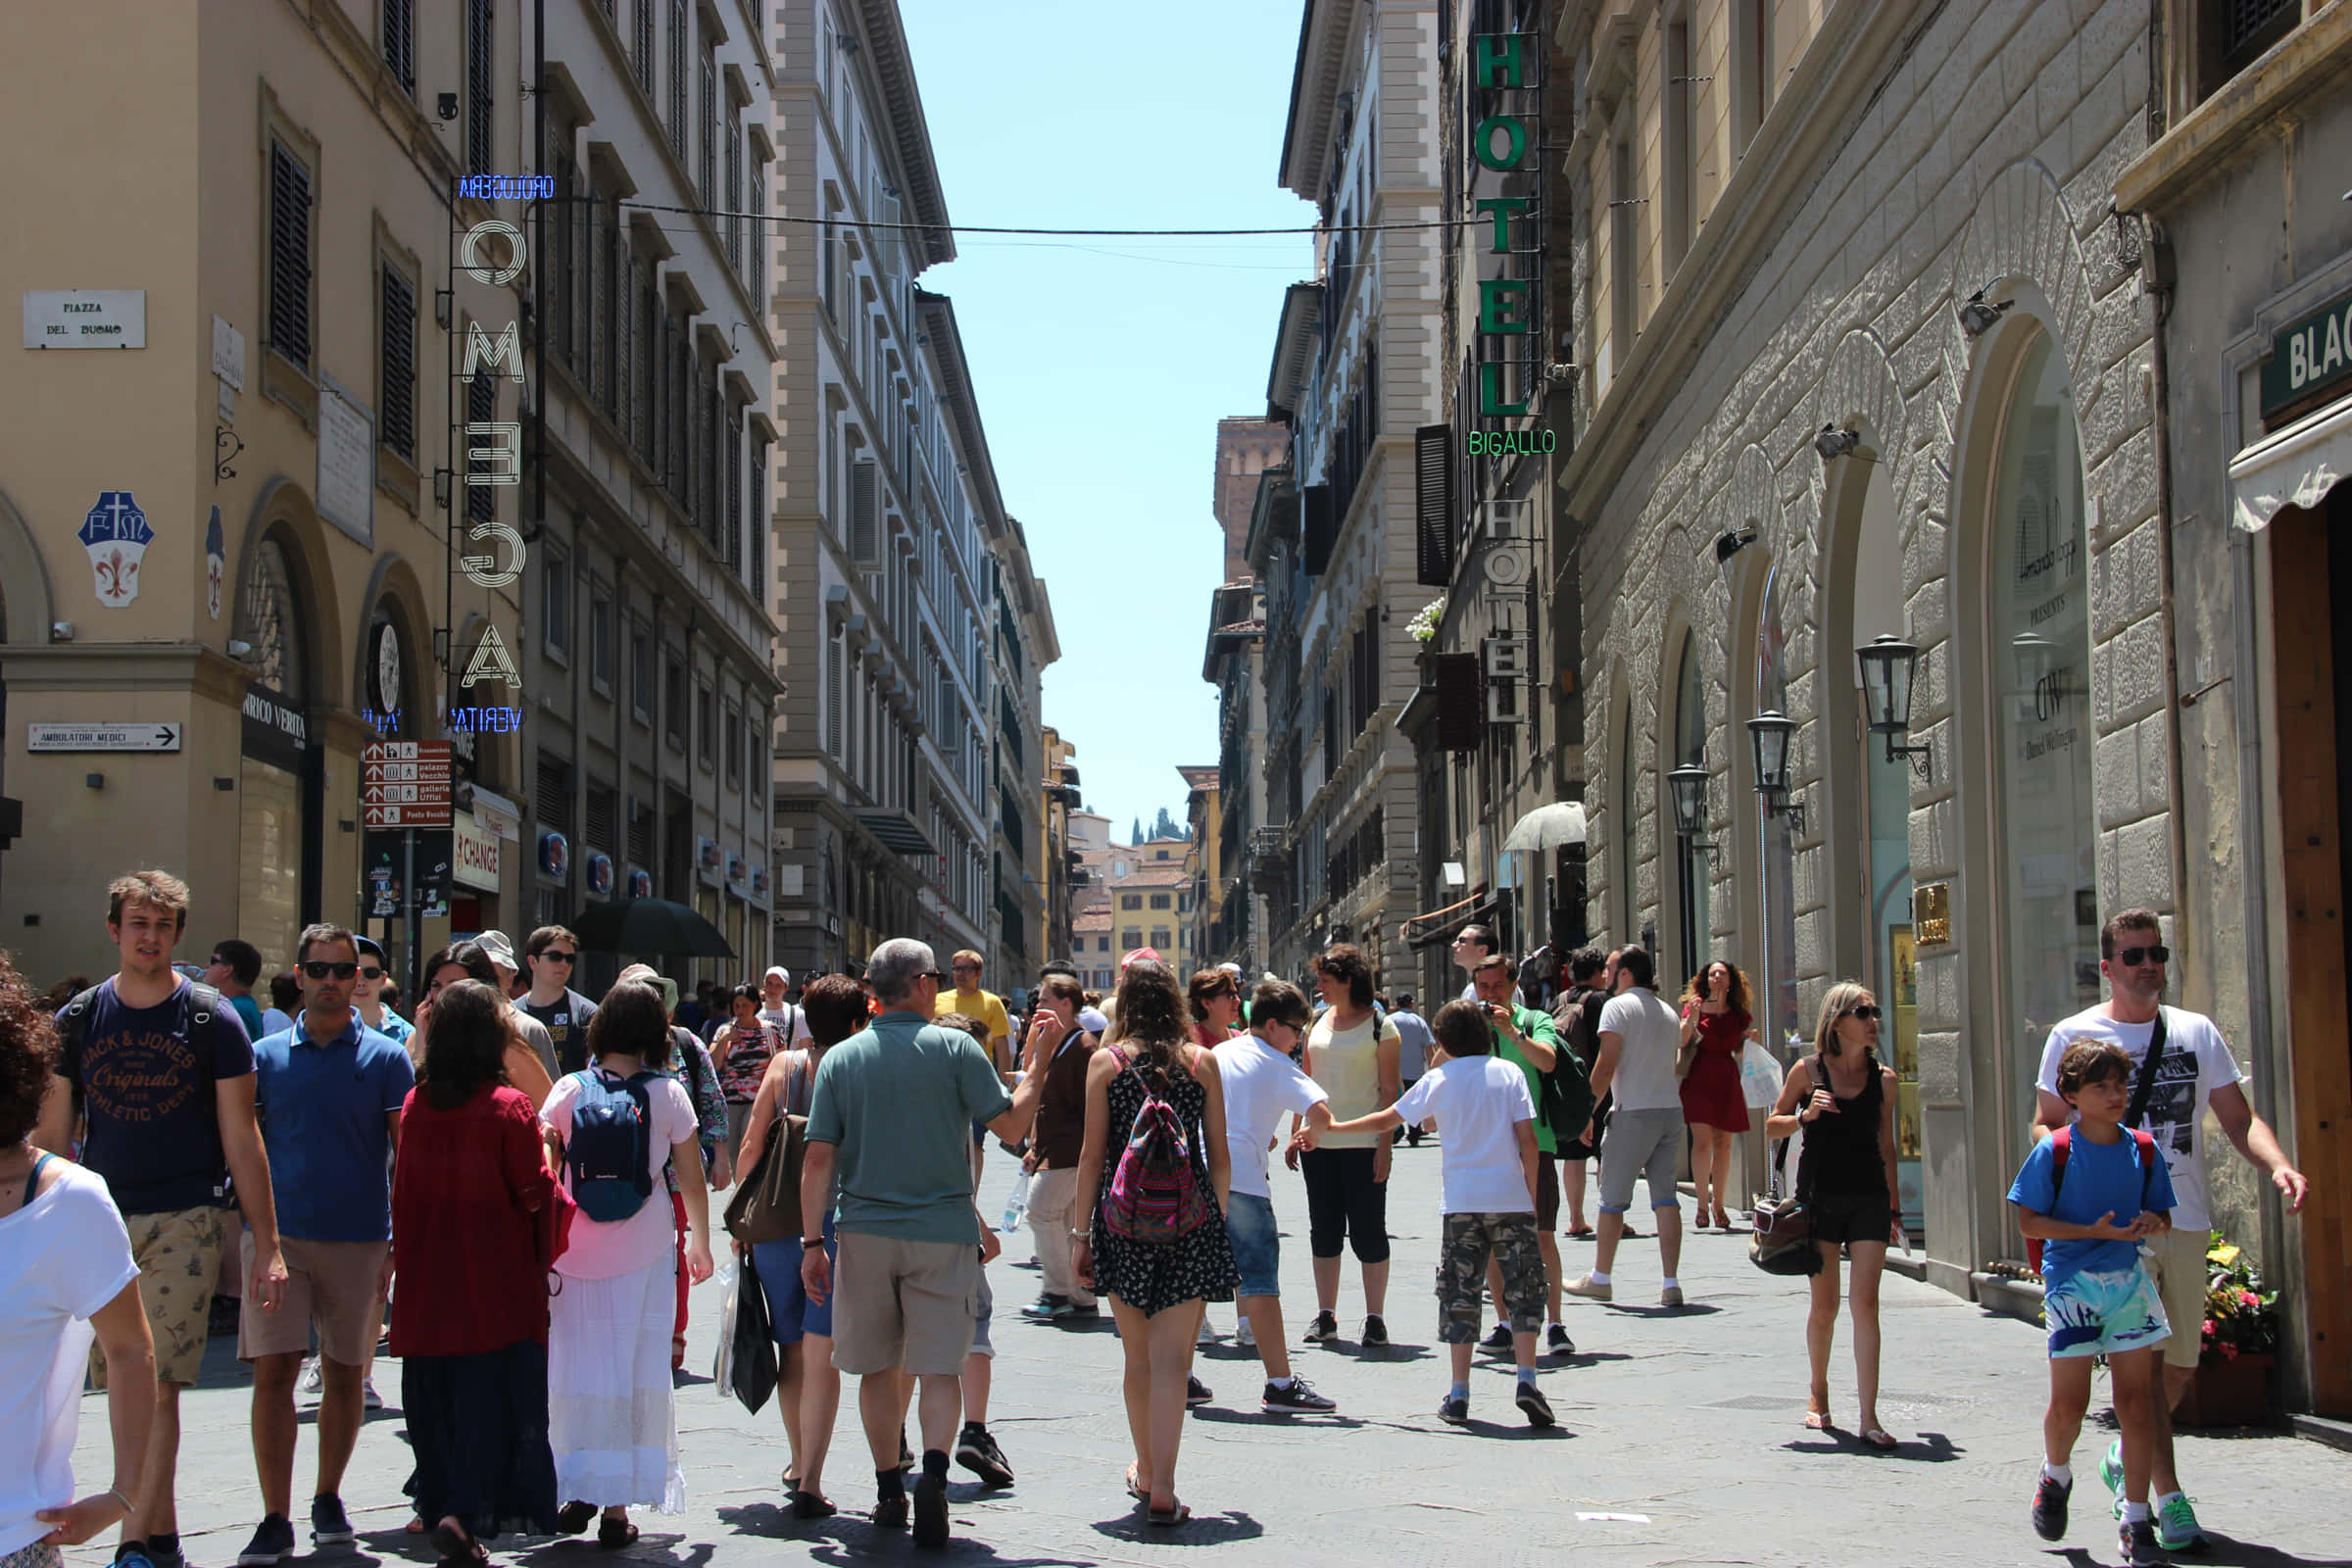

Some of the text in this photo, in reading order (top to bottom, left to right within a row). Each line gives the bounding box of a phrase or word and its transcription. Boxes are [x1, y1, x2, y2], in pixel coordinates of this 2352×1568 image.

[1475, 33, 1528, 416] HOTEL
[63, 303, 102, 313] PIAZZA
[46, 325, 122, 334] DEL DUOMO
[1469, 430, 1556, 455] BIGALLO
[1483, 500, 1525, 723] HOTEL
[2030, 593, 2065, 627] PRESENTS
[40, 732, 126, 742] AMBULATORI MEDICI
[418, 763, 450, 772] palazzo
[419, 784, 451, 794] galleria
[419, 792, 442, 801] Uffizi
[464, 837, 498, 874] CHANGE
[82, 1030, 196, 1069] JACK & JONES
[92, 1062, 179, 1091] Originals
[85, 1084, 151, 1121] ATHLETIC
